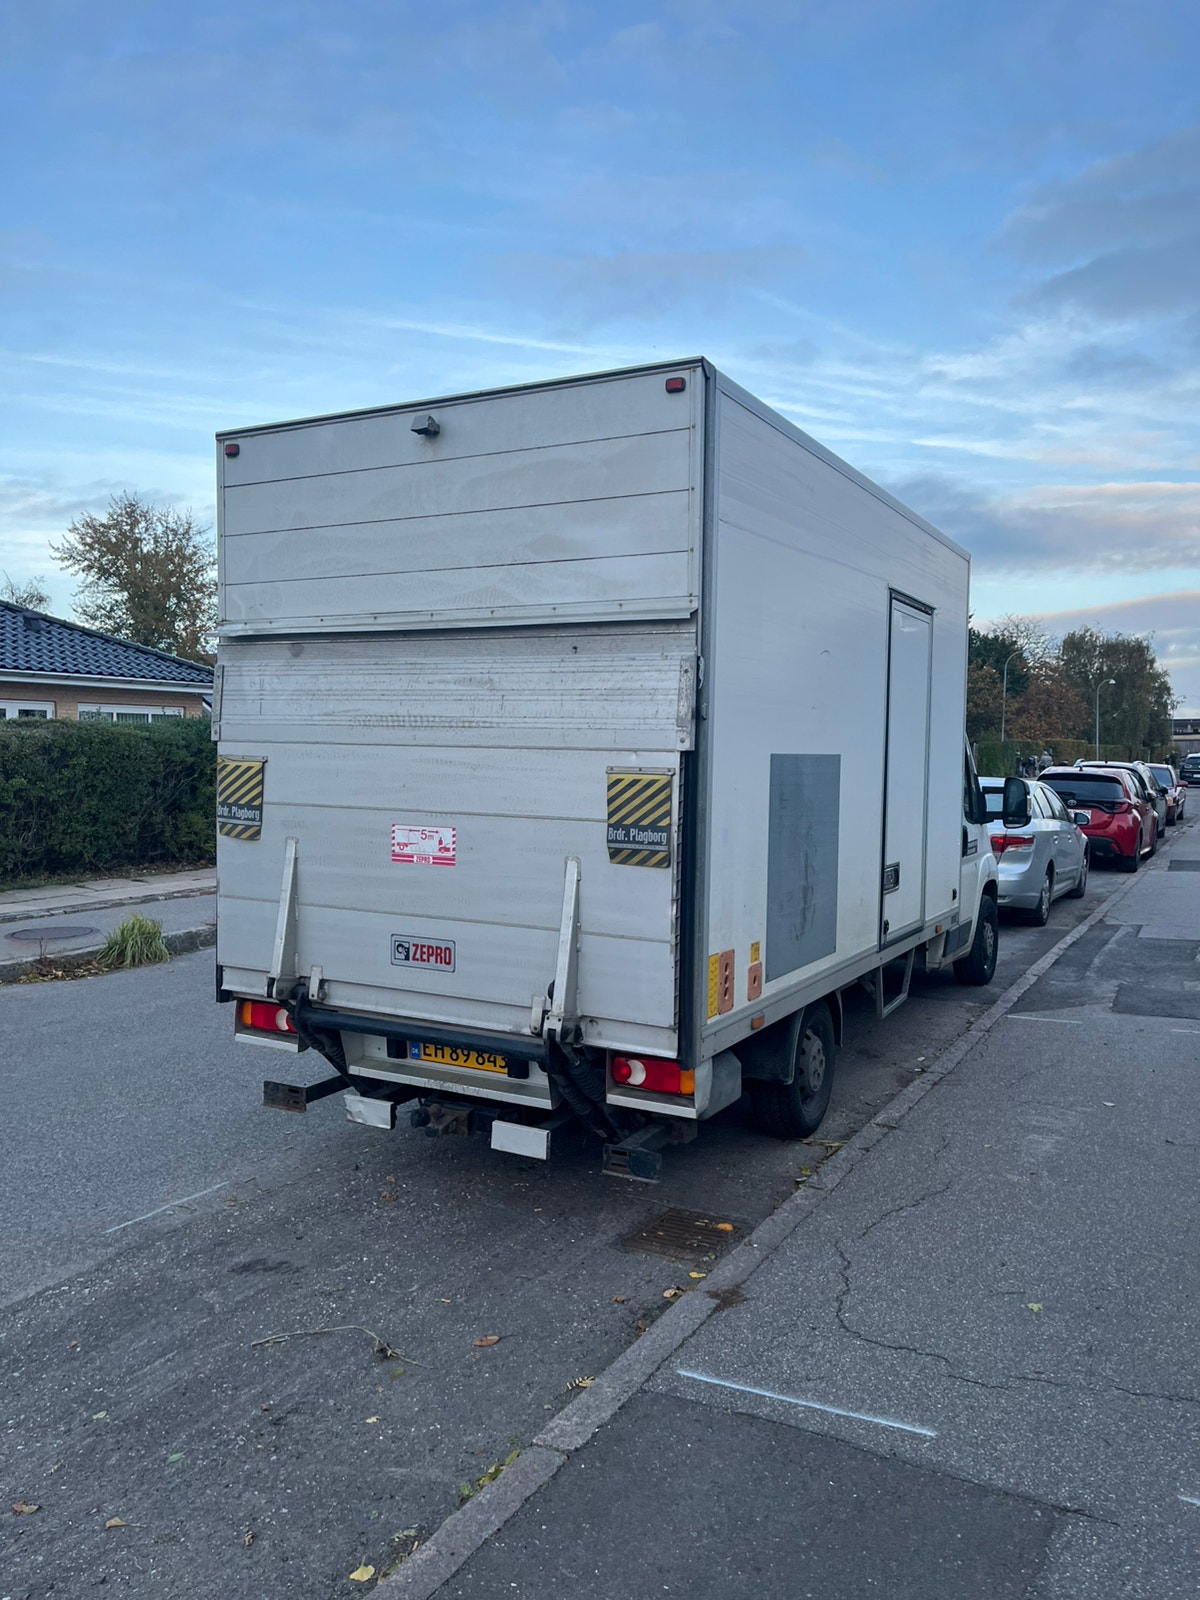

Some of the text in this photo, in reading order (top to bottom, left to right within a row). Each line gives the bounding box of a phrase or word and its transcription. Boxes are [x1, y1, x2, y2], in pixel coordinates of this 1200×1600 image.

[231, 806, 259, 820] Plagborg
[608, 827, 667, 844] Brdr. Plagborg
[411, 943, 452, 966] ZEPRO
